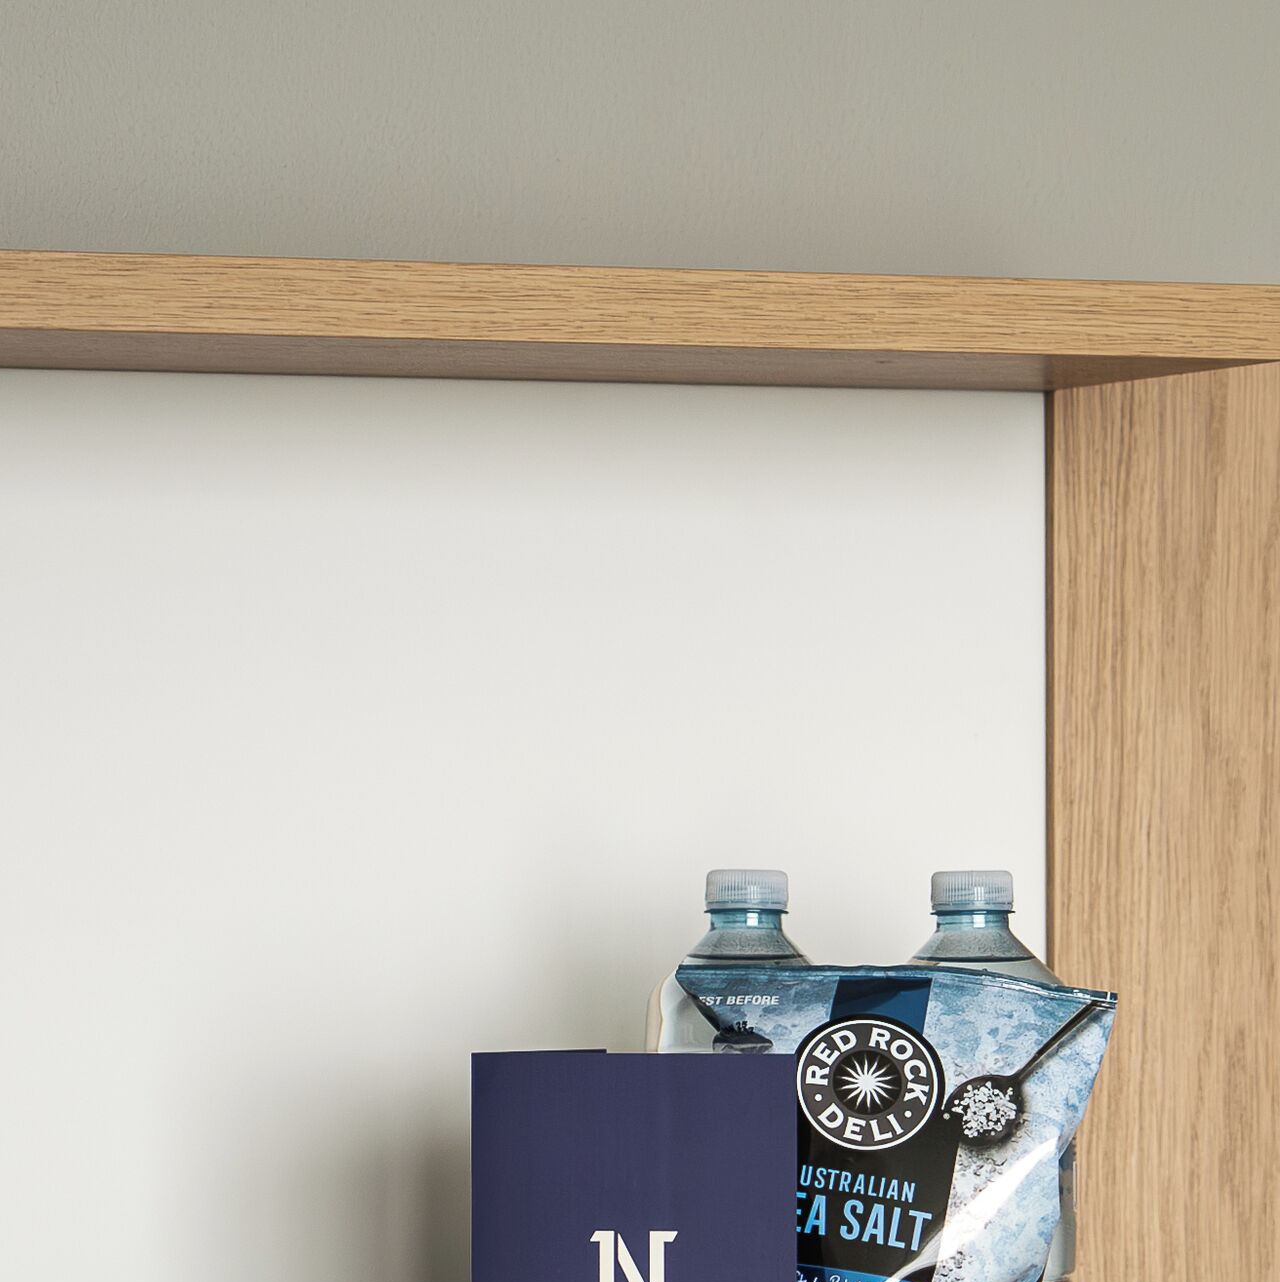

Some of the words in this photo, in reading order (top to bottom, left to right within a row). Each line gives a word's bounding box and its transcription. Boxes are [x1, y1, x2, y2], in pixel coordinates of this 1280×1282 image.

[726, 995, 780, 1005] BEFORE
[805, 1029, 857, 1086] RED
[868, 1027, 930, 1106] ROCK
[817, 1102, 904, 1142] DELI
[800, 1164, 916, 1203] USTRALIAN
[840, 1199, 933, 1251] SALT
